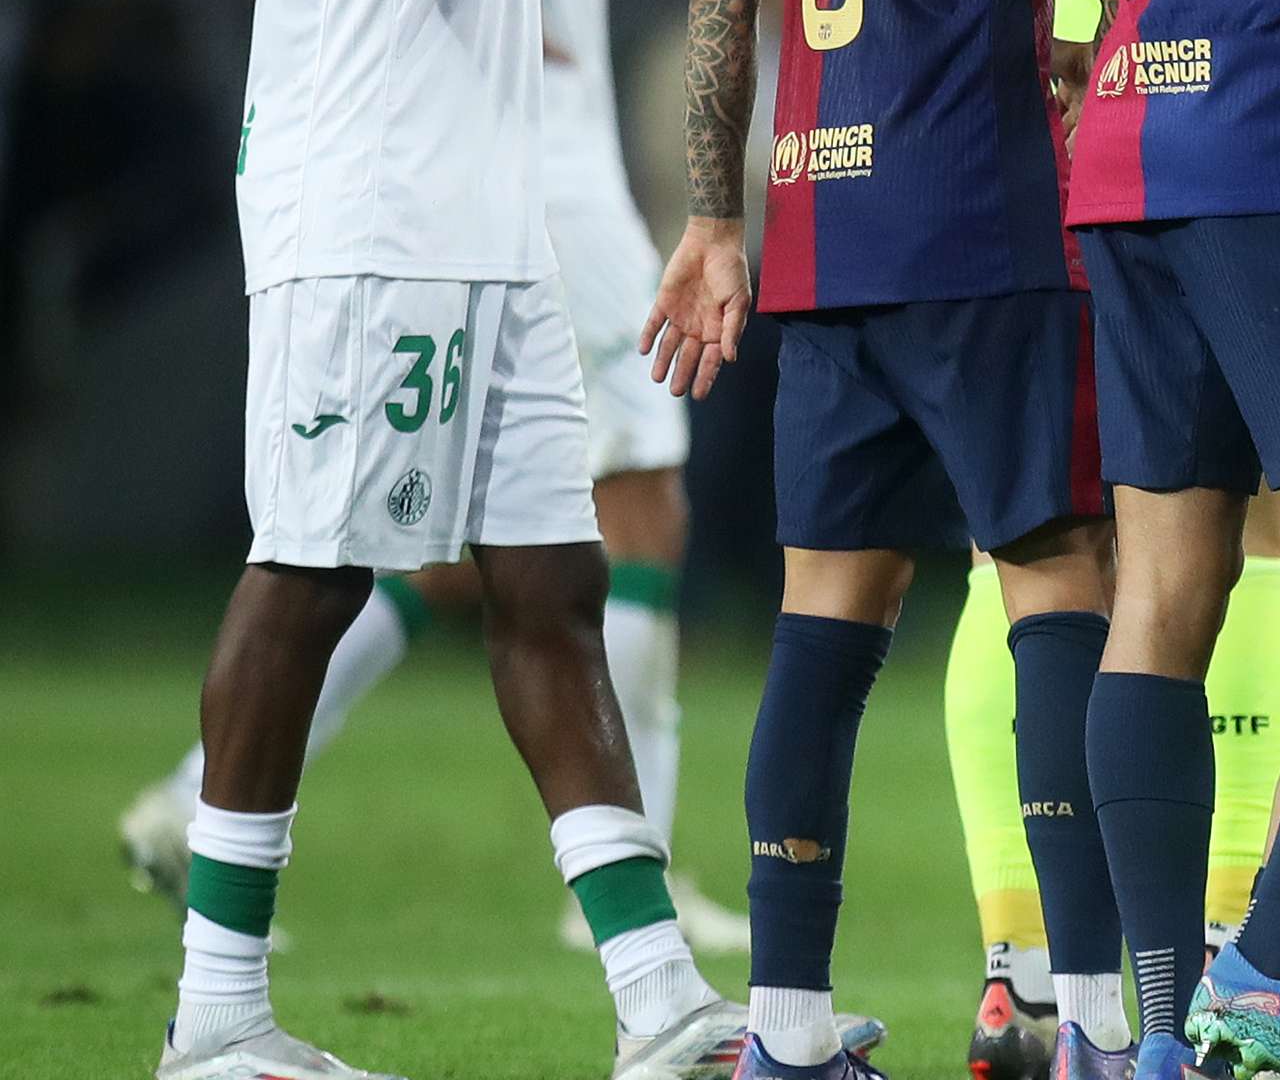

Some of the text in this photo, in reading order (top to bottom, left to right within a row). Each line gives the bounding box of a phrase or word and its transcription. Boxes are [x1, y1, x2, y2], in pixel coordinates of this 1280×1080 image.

[1131, 39, 1211, 63] UNHCR
[1134, 61, 1211, 85] ACNUR
[809, 123, 873, 150] UNHCR
[808, 146, 873, 172] ACNUR
[385, 328, 464, 433] 36
